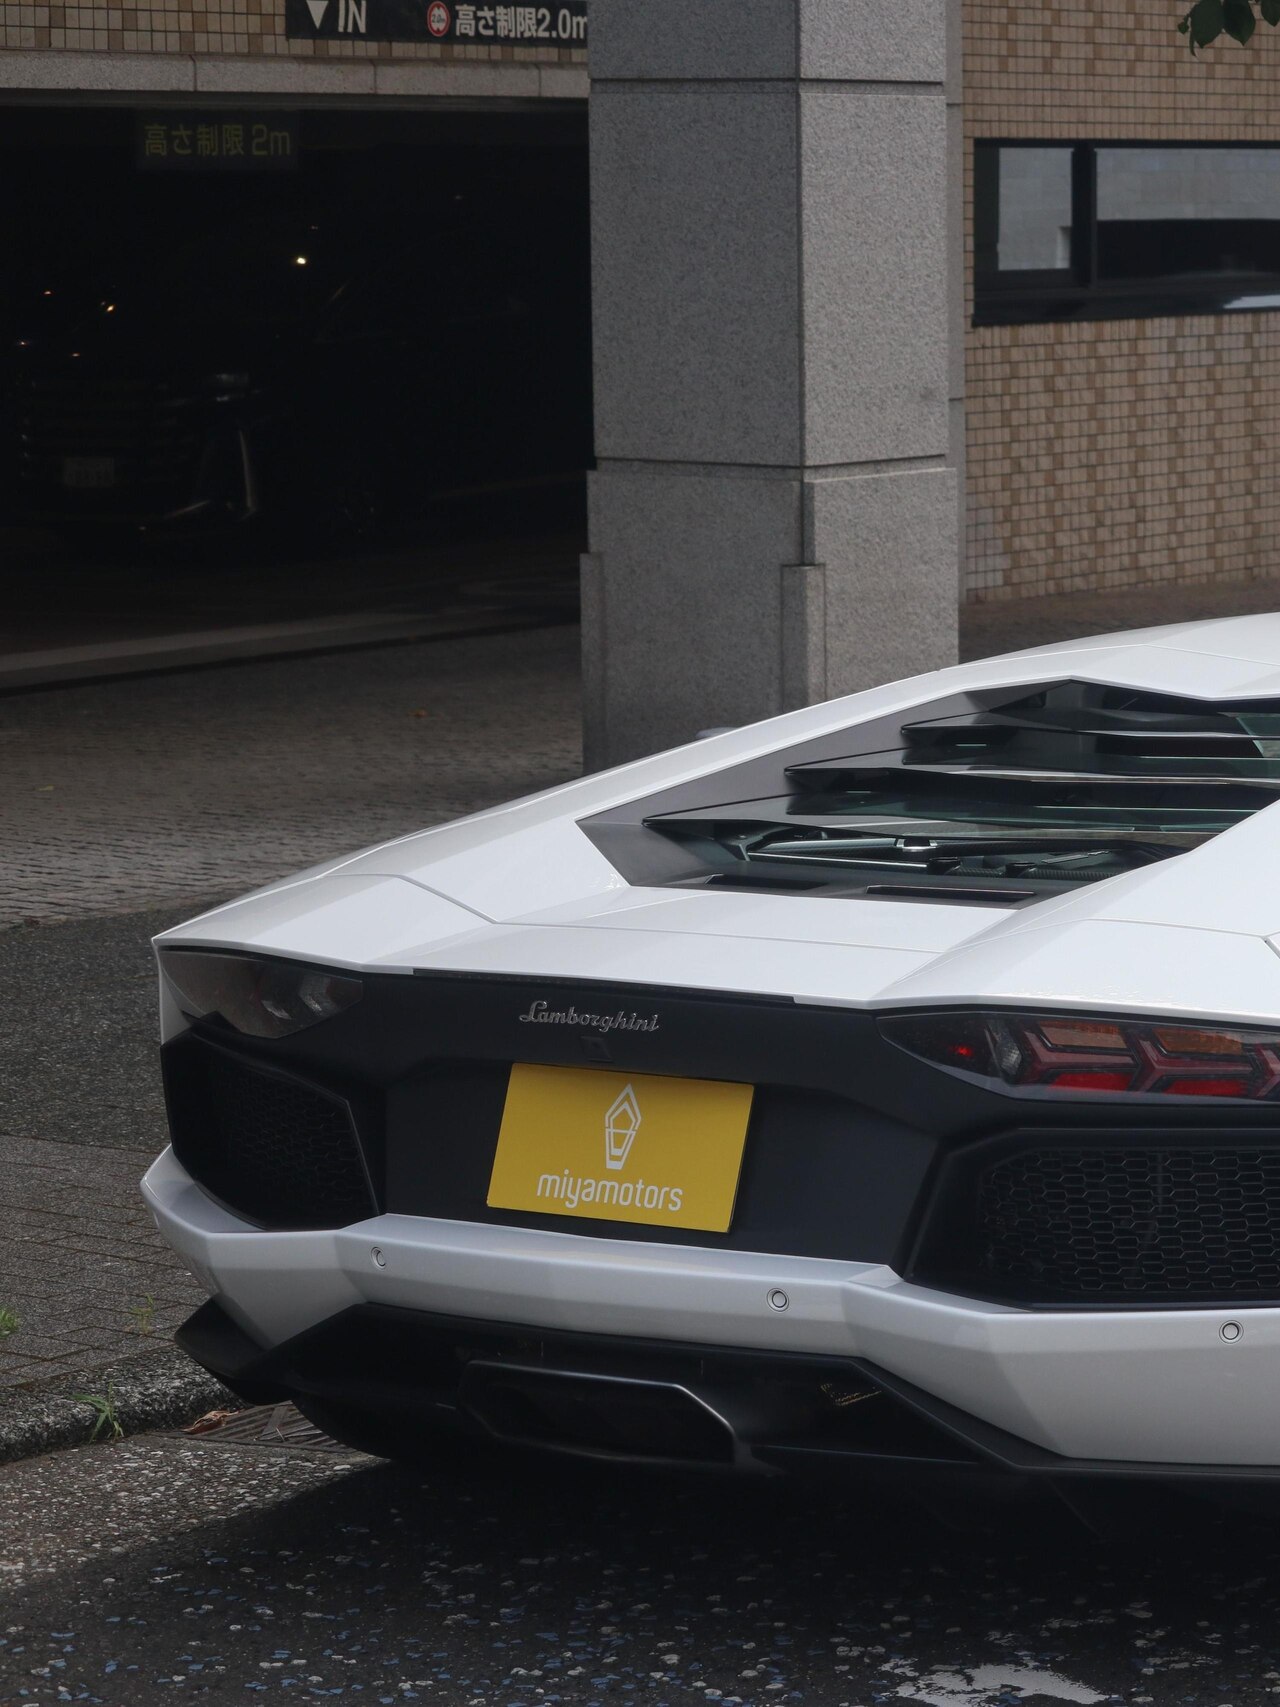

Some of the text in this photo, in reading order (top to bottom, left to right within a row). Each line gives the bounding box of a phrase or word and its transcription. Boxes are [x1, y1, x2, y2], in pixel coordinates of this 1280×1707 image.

[338, 0, 366, 33] IN
[519, 1000, 660, 1033] Lamborghini
[537, 1169, 683, 1211] miyamotors
